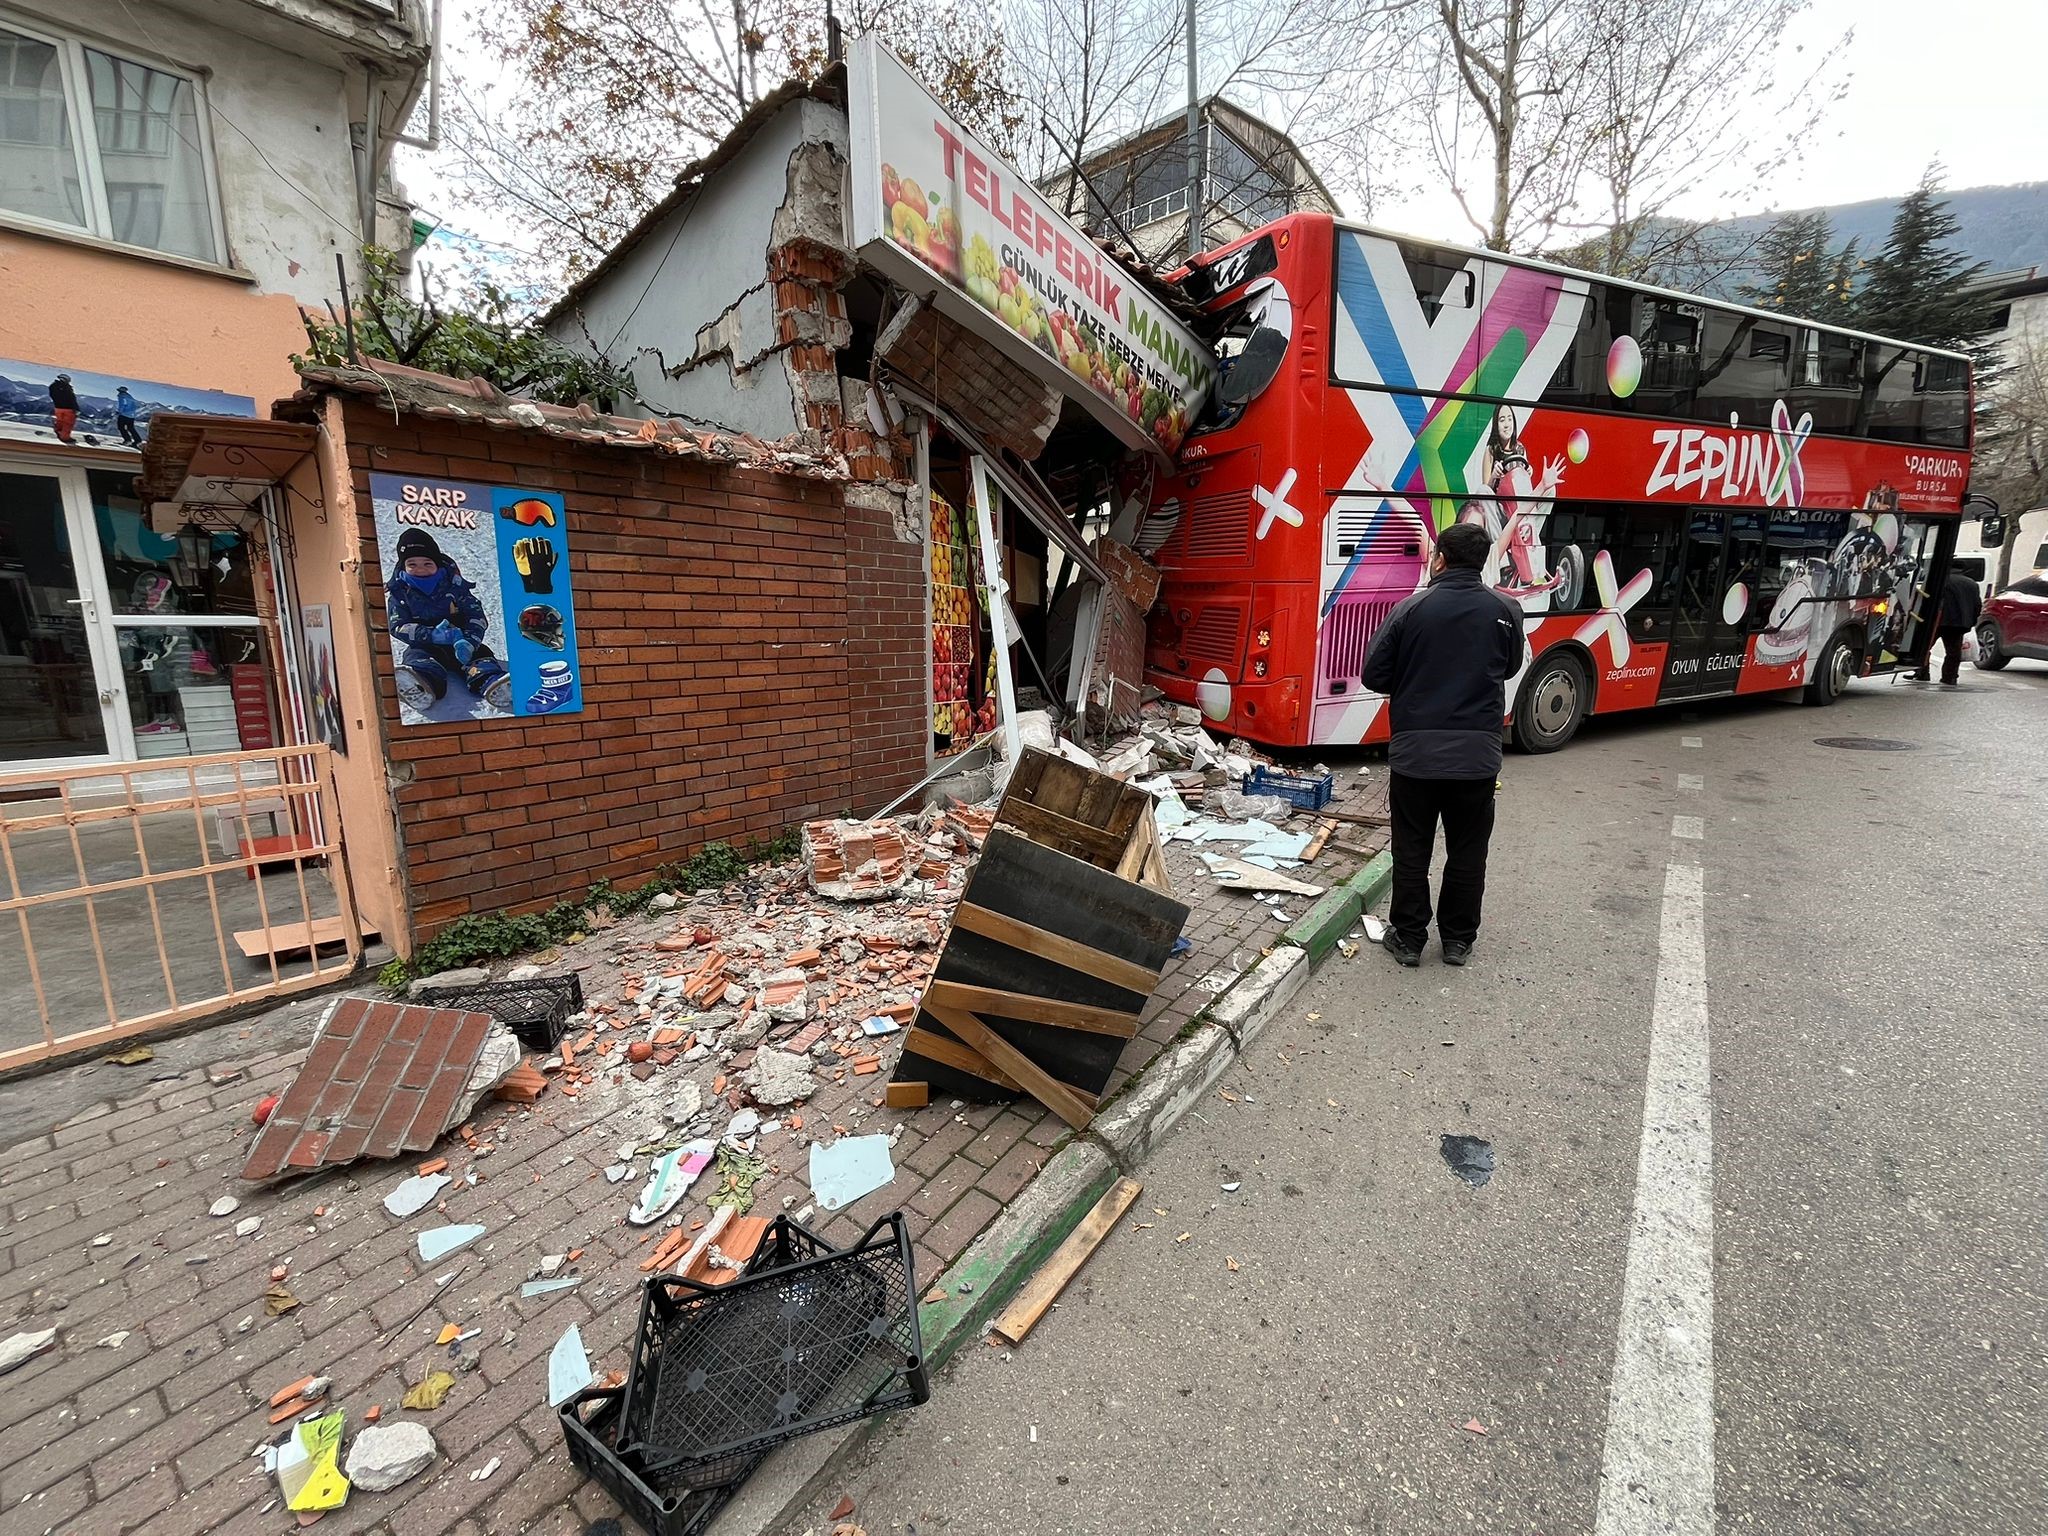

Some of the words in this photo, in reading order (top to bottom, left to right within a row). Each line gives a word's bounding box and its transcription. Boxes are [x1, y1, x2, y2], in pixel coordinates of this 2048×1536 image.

[934, 119, 1123, 324] TELEFERİK
[1000, 243, 1069, 314] GÜNLÜK
[1071, 300, 1106, 345] TAZE
[1109, 332, 1144, 376] SEBZE
[1146, 363, 1181, 404] MEYVE
[1908, 455, 1959, 478] PARKUR
[401, 484, 467, 508] SARP
[1915, 480, 1948, 492] BURSA
[395, 504, 477, 530] KAYAK
[1605, 664, 1656, 683] zeplinx.com
[1671, 658, 1700, 676] OYUN
[1706, 652, 1748, 672] EĞLENCE
